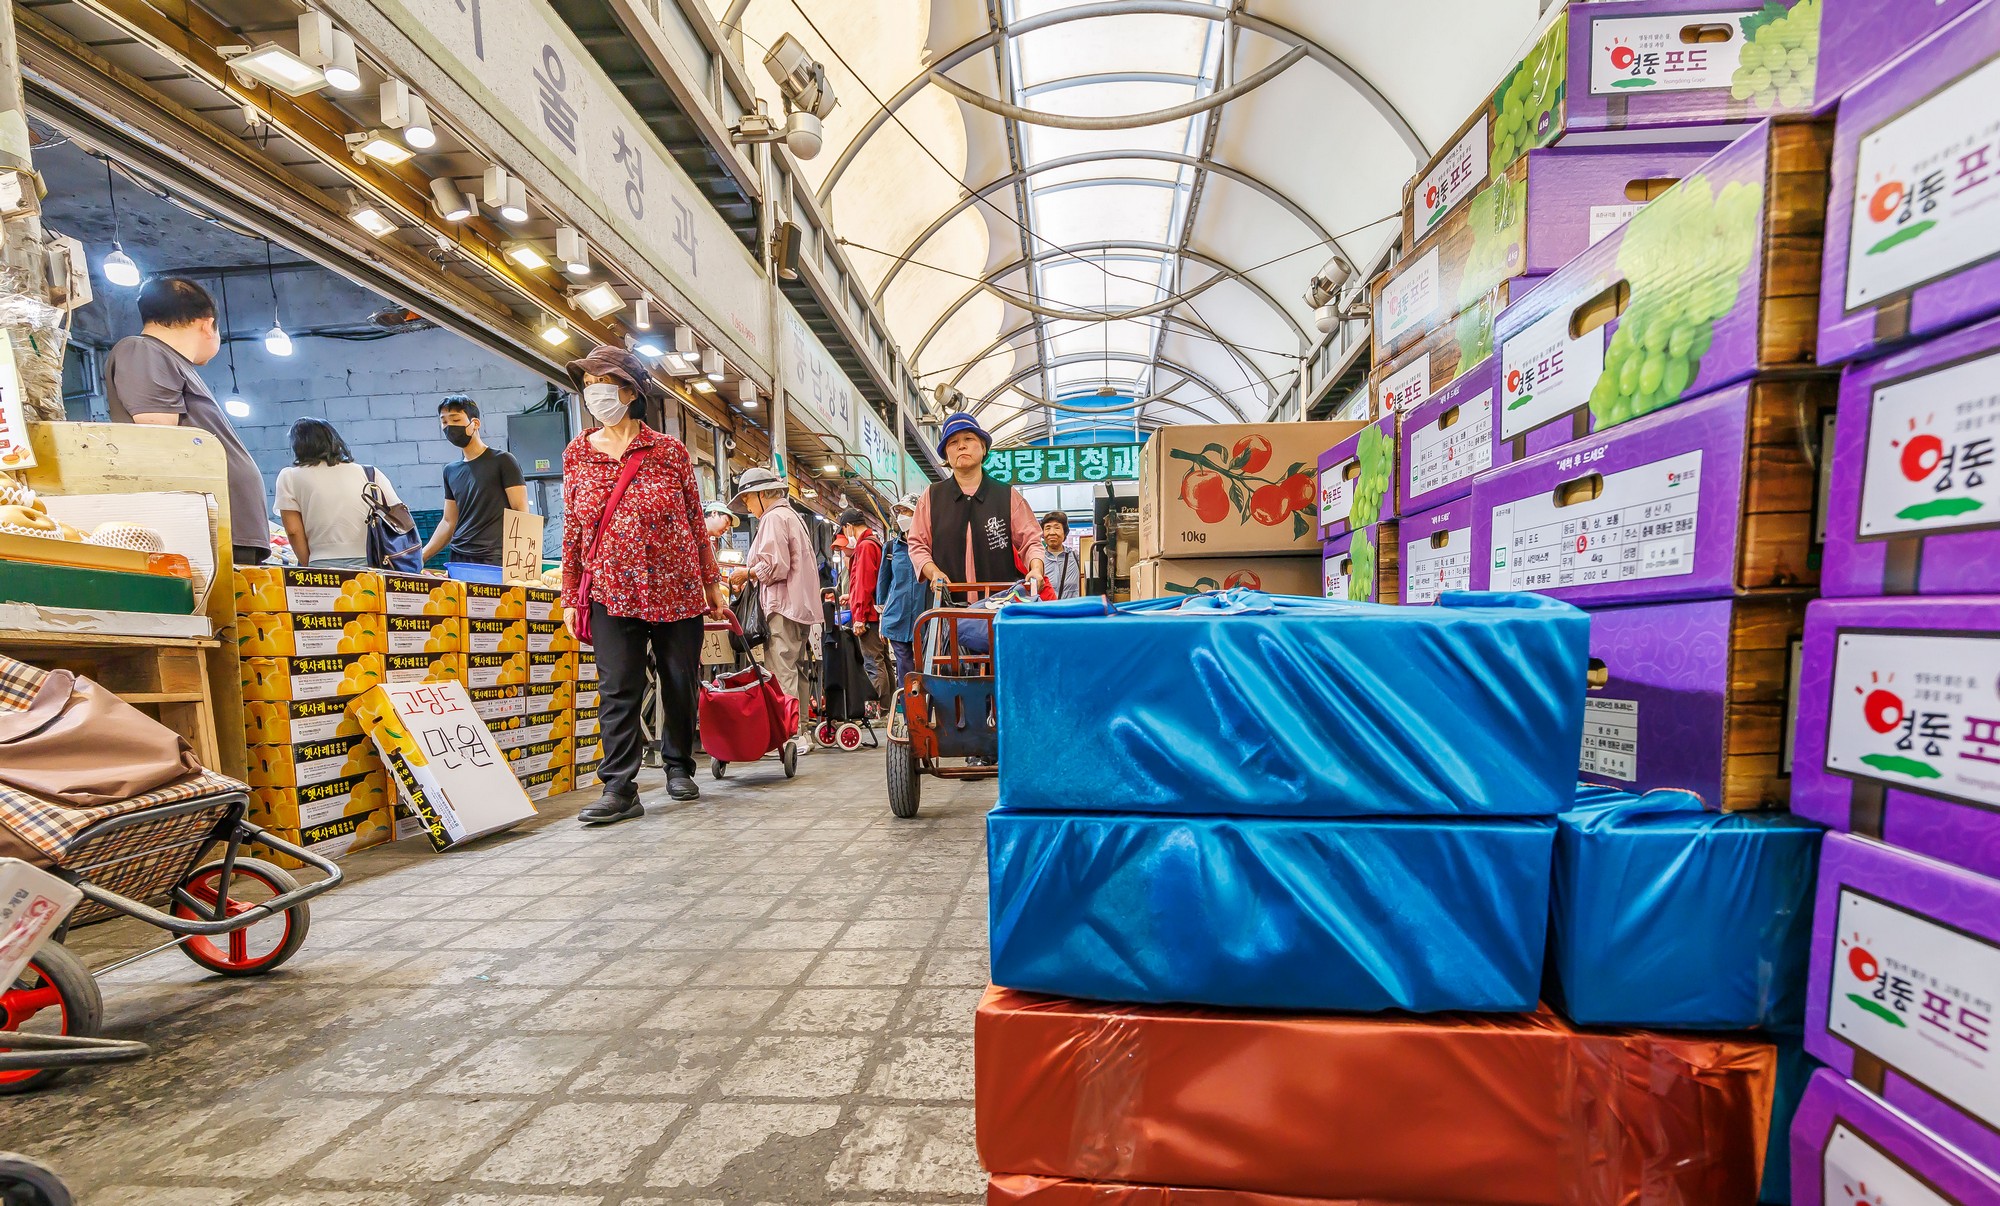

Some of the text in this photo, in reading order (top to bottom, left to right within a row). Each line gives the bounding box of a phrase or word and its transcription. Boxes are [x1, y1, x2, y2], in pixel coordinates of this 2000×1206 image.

[1611, 46, 1707, 76] 영동 포도
[1450, 154, 1472, 193] 포도
[1868, 169, 1946, 226] 영동
[1952, 141, 2000, 197] 포
[1507, 367, 1535, 396] 영동
[1537, 350, 1564, 384] 포도
[1404, 380, 1422, 405] 포도
[1574, 453, 1582, 467] 후
[1901, 433, 1994, 493] 영동
[1181, 530, 1206, 543] 10kg
[1624, 528, 1638, 540] 주소
[295, 572, 323, 586] 햇사레
[1583, 571, 1597, 581] 202
[1601, 568, 1608, 579] 년
[302, 616, 327, 629] 햇사레
[299, 660, 326, 673] 햇사레
[299, 701, 326, 716] 햇사레
[391, 686, 465, 715] 고당도
[1864, 689, 1951, 757] 영동
[304, 744, 330, 760] 햇사레
[423, 724, 494, 770] 만원
[307, 784, 334, 801] 햇사레
[311, 826, 338, 842] 햇사레
[1848, 947, 1915, 1014] 영동
[1918, 989, 1991, 1052] 포도
